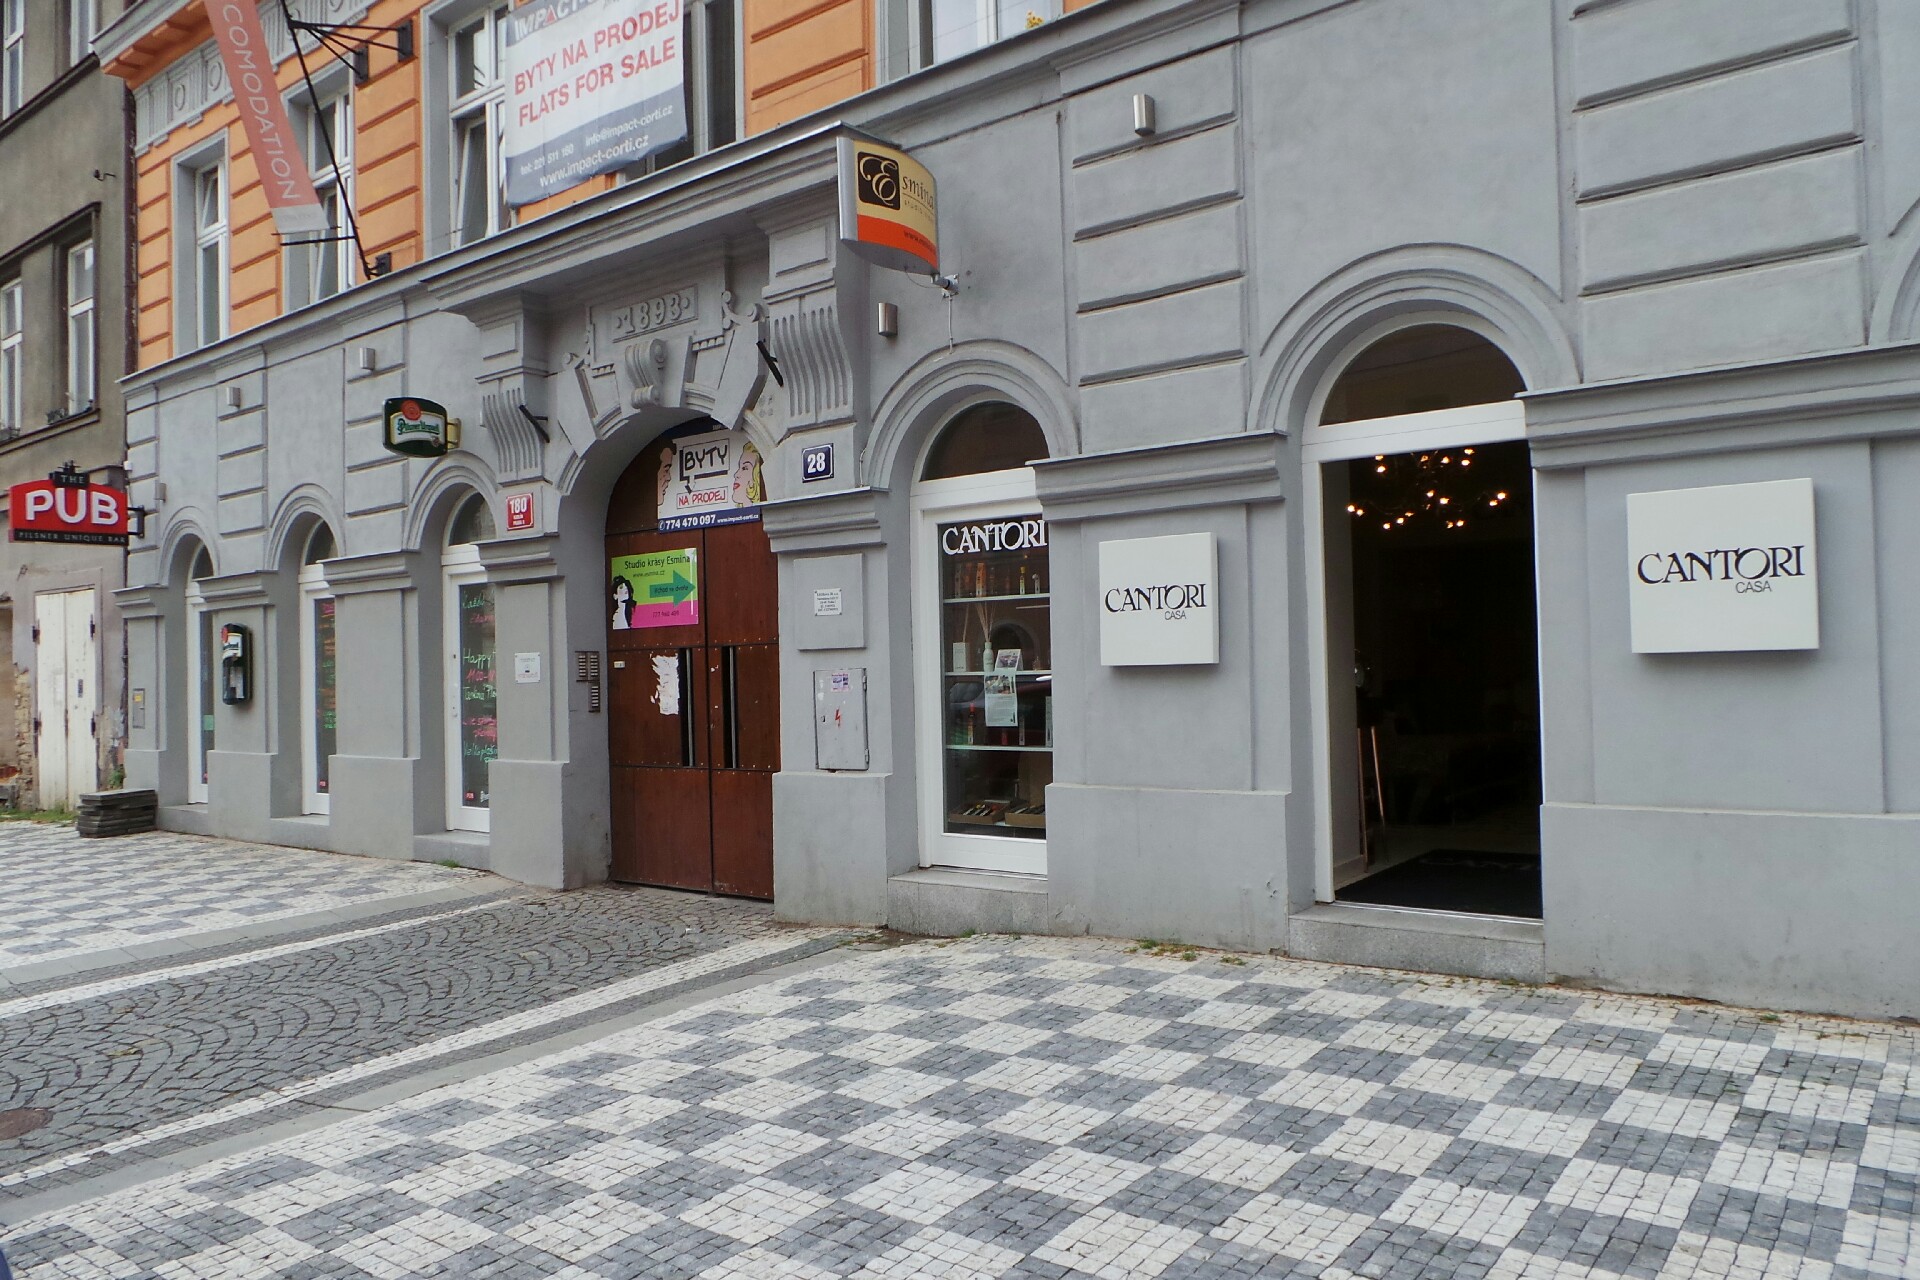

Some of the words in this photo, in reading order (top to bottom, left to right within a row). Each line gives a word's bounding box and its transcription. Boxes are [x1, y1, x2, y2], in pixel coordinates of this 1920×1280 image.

[514, 53, 557, 96] BYTY
[562, 39, 589, 69] NA
[594, 0, 680, 53] PRODEJ
[518, 83, 569, 127] FLATS
[575, 62, 614, 99] FOR
[620, 36, 676, 78] SALE
[222, 0, 301, 200] COMODATION
[585, 104, 673, 147] info@impact-corti.cz
[539, 133, 649, 188] www.impact-corti.cz
[624, 293, 683, 334] 1893
[684, 444, 728, 471] BYTY
[806, 452, 827, 474] 28
[61, 475, 85, 484] THE
[25, 487, 119, 525] PUB
[510, 497, 528, 514] 180
[678, 493, 689, 507] NA
[692, 490, 726, 505] PRODEJ
[665, 518, 681, 530] 774
[682, 516, 699, 528] 470
[700, 514, 717, 526] 097
[18, 531, 59, 541] PILSNER
[64, 533, 103, 543] UNIQUE
[942, 519, 1048, 555] CANTORI
[624, 560, 646, 570] Studio
[666, 554, 691, 565] Esmina
[1637, 545, 1806, 585] CANTORI
[1104, 583, 1207, 613] CANTORI
[1735, 580, 1772, 594] CASA
[1164, 610, 1187, 621] CASA
